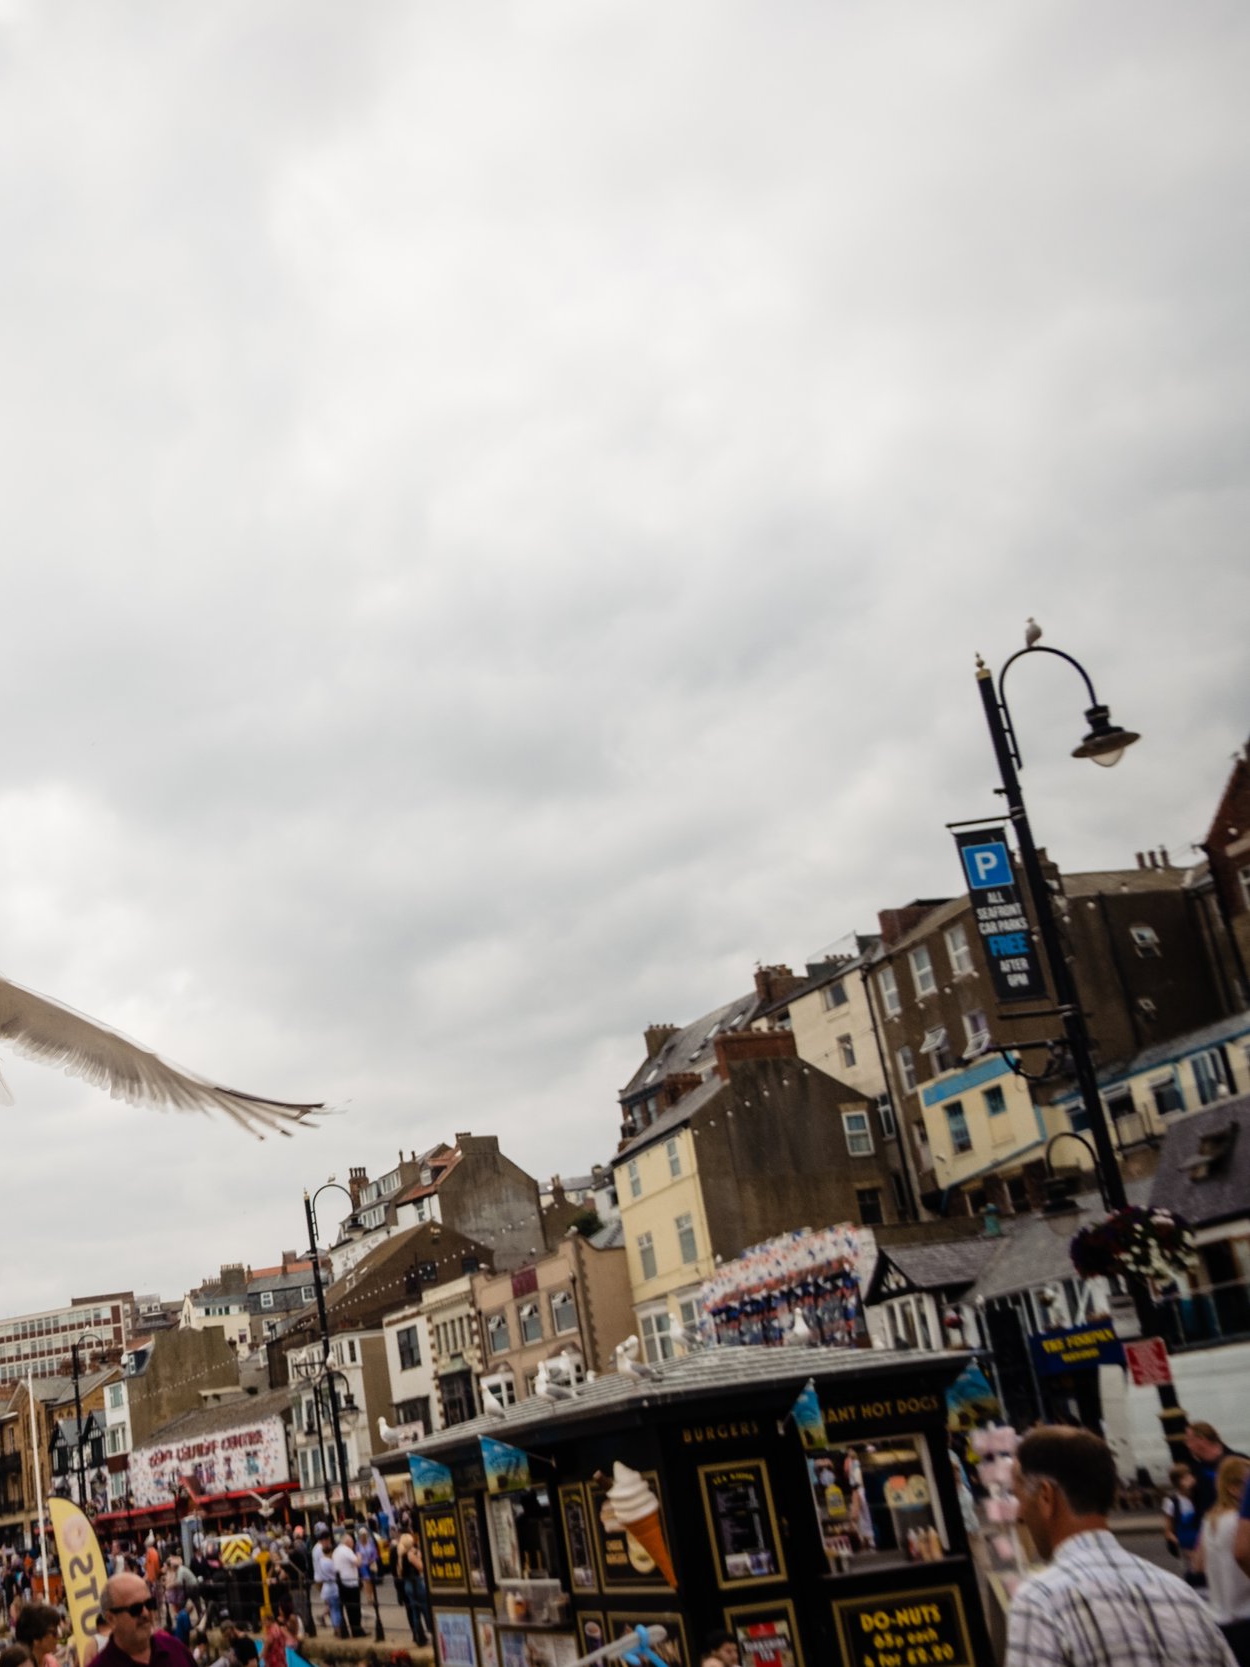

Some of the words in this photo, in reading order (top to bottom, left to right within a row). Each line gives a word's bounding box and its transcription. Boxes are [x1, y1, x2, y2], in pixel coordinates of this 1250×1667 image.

[974, 851, 998, 881] P
[987, 891, 1006, 904] ALL
[976, 902, 1023, 921] SEAFRONT
[978, 920, 998, 935] CAR
[998, 917, 1029, 932] PARKS
[988, 932, 1031, 957] FREE
[1000, 957, 1030, 973] AFTER
[821, 1405, 856, 1422] IANT
[861, 1400, 892, 1418] HOT
[896, 1396, 939, 1414] DOGS
[682, 1420, 759, 1443] BURGERS
[860, 1603, 942, 1633] DO-NUTS
[907, 1626, 939, 1645] each
